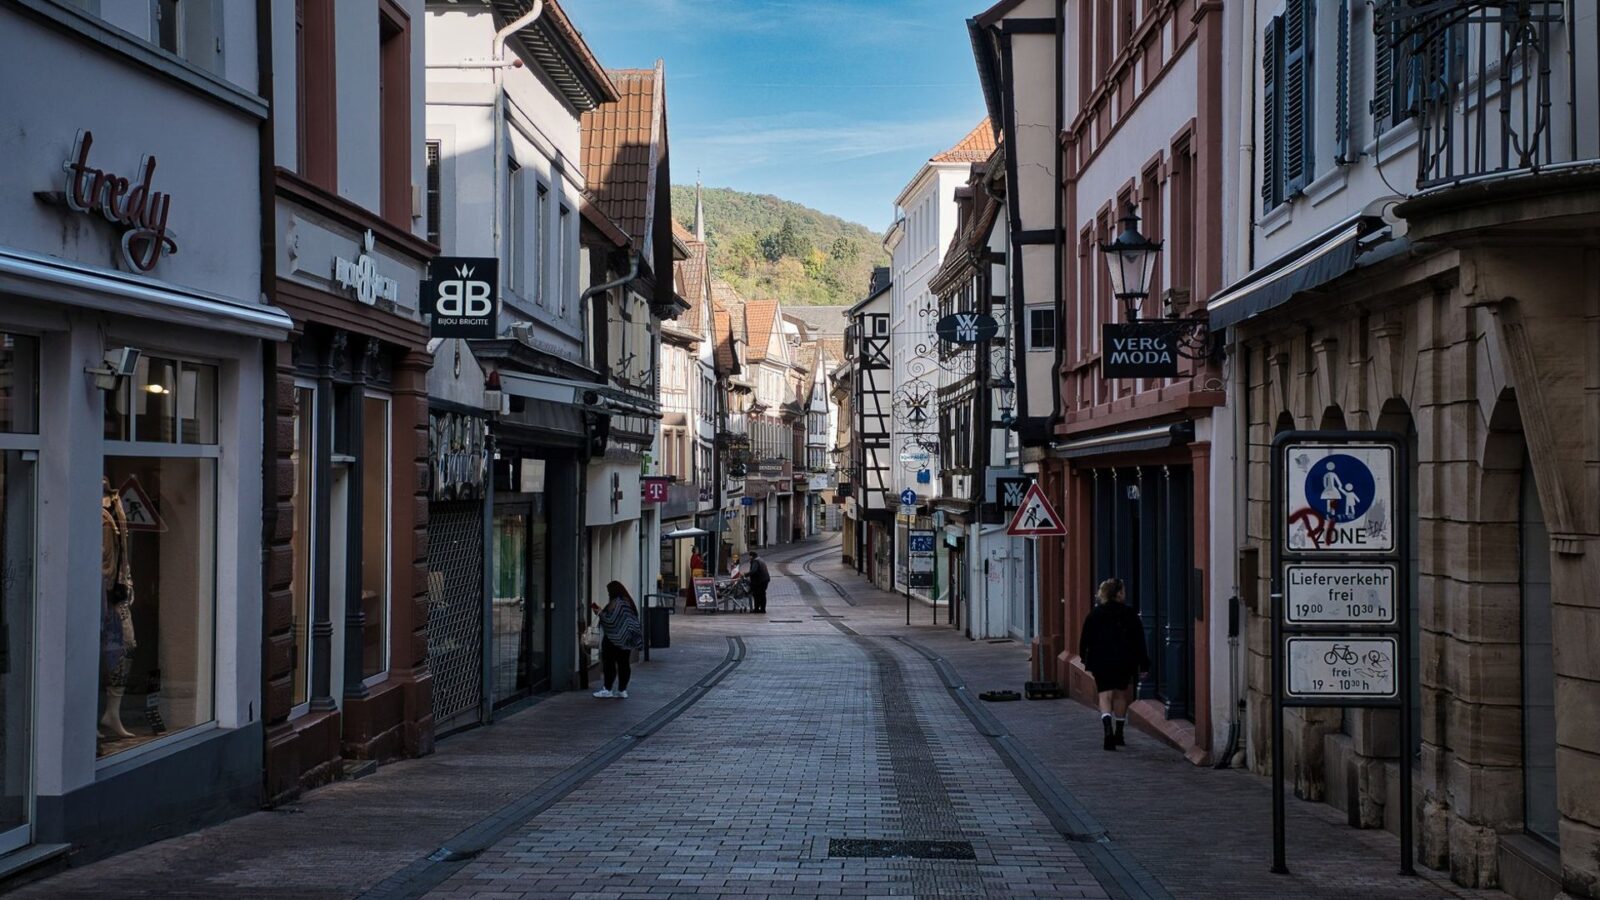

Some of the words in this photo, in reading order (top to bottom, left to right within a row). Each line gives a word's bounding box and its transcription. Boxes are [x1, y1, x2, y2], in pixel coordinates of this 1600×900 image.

[64, 129, 178, 272] tredy
[438, 317, 458, 326] BIJOU
[459, 318, 489, 326] BRIGITTE
[1110, 351, 1172, 365] MODA
[650, 483, 663, 499] T
[1291, 572, 1390, 586] Lieferverkehr
[1328, 588, 1354, 601] frei
[1378, 605, 1387, 617] h
[1332, 667, 1351, 678] frei
[1312, 679, 1324, 690] 19
[1362, 679, 1370, 690] h
